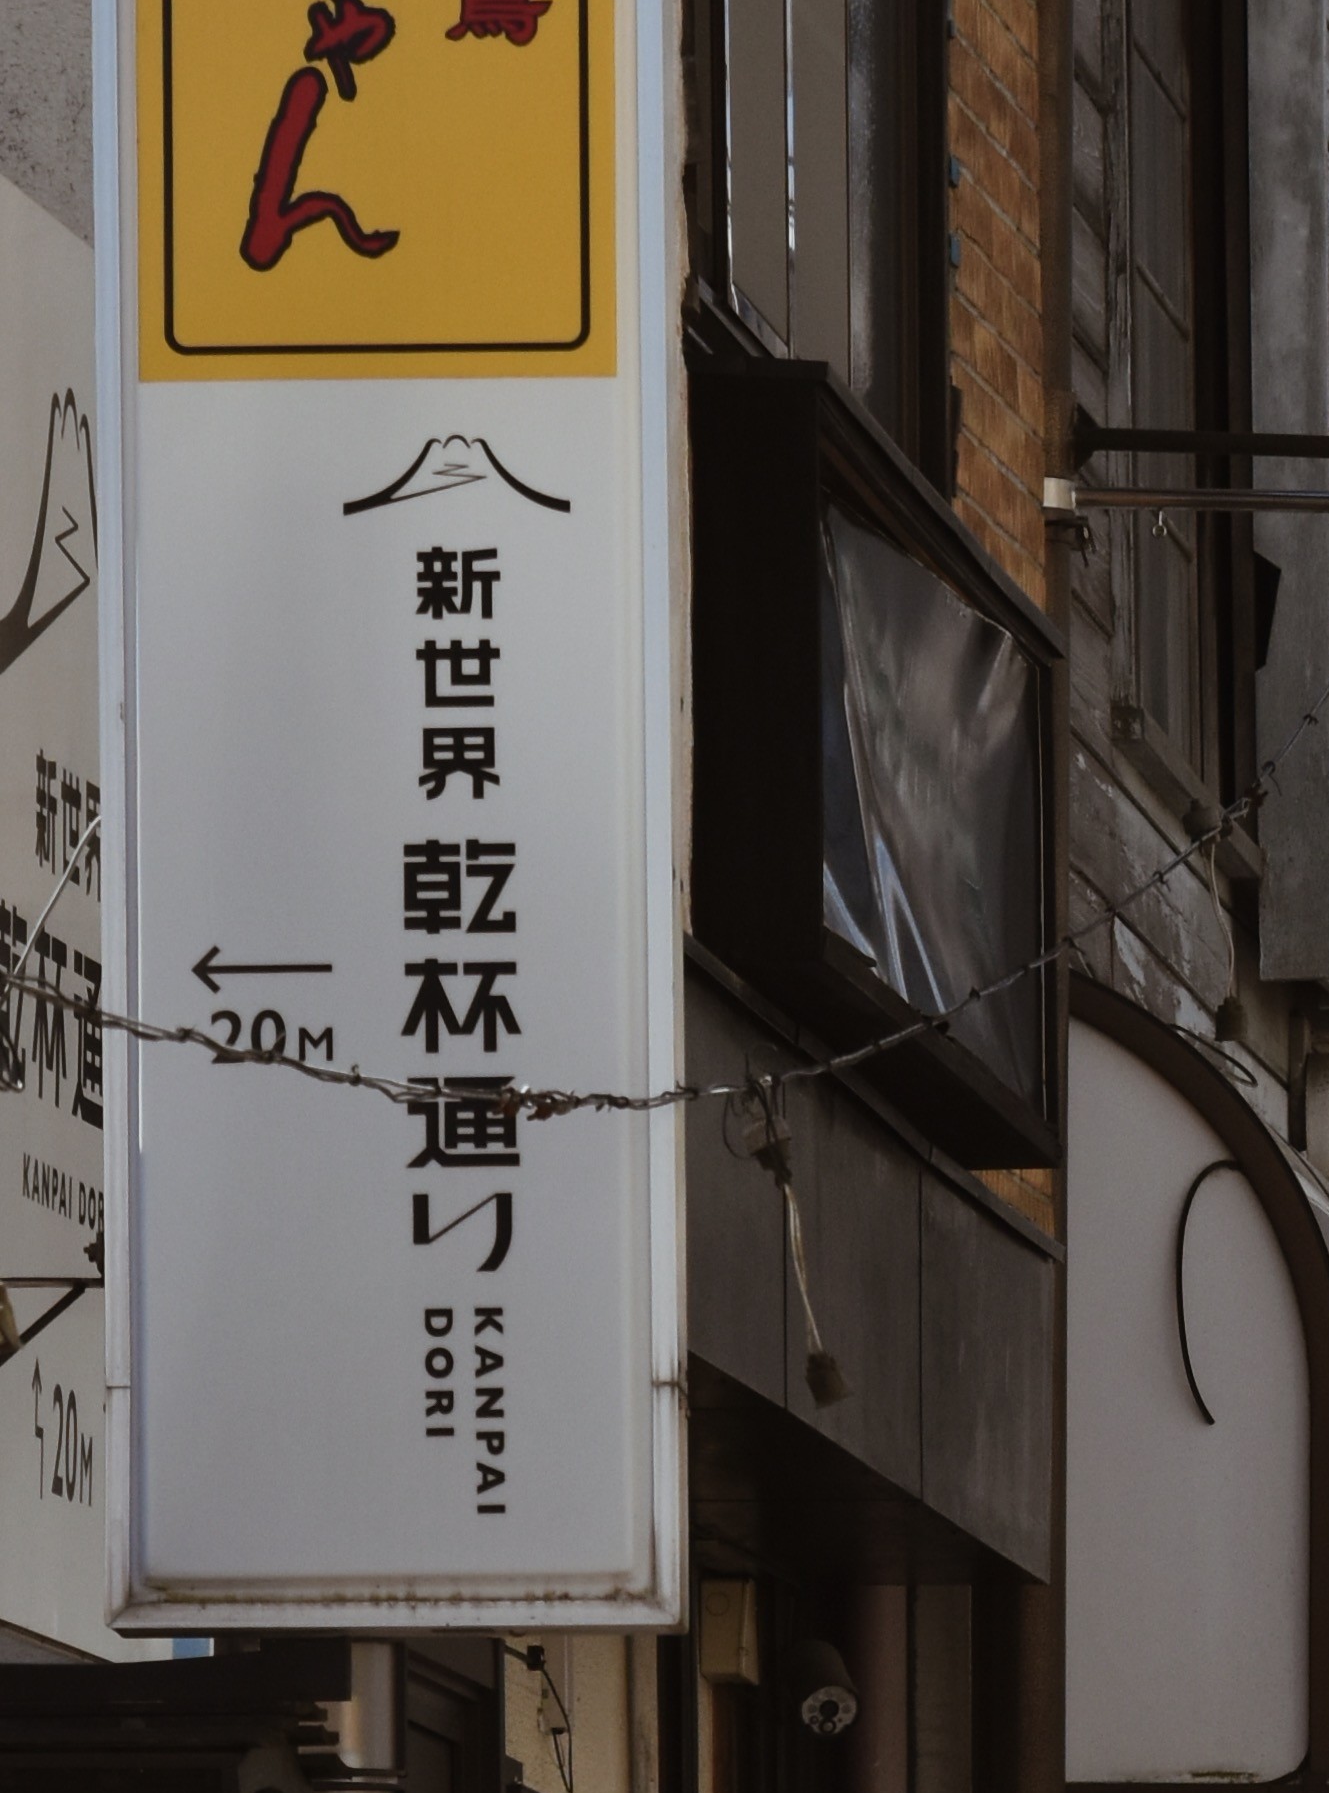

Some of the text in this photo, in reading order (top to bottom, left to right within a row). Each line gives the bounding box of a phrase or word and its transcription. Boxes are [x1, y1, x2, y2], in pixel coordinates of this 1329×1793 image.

[401, 546, 522, 1272] 新世界 乾杯通り
[23, 1152, 73, 1220] KANPAI
[424, 1308, 455, 1438] DORI
[473, 1307, 506, 1514] KANPAI
